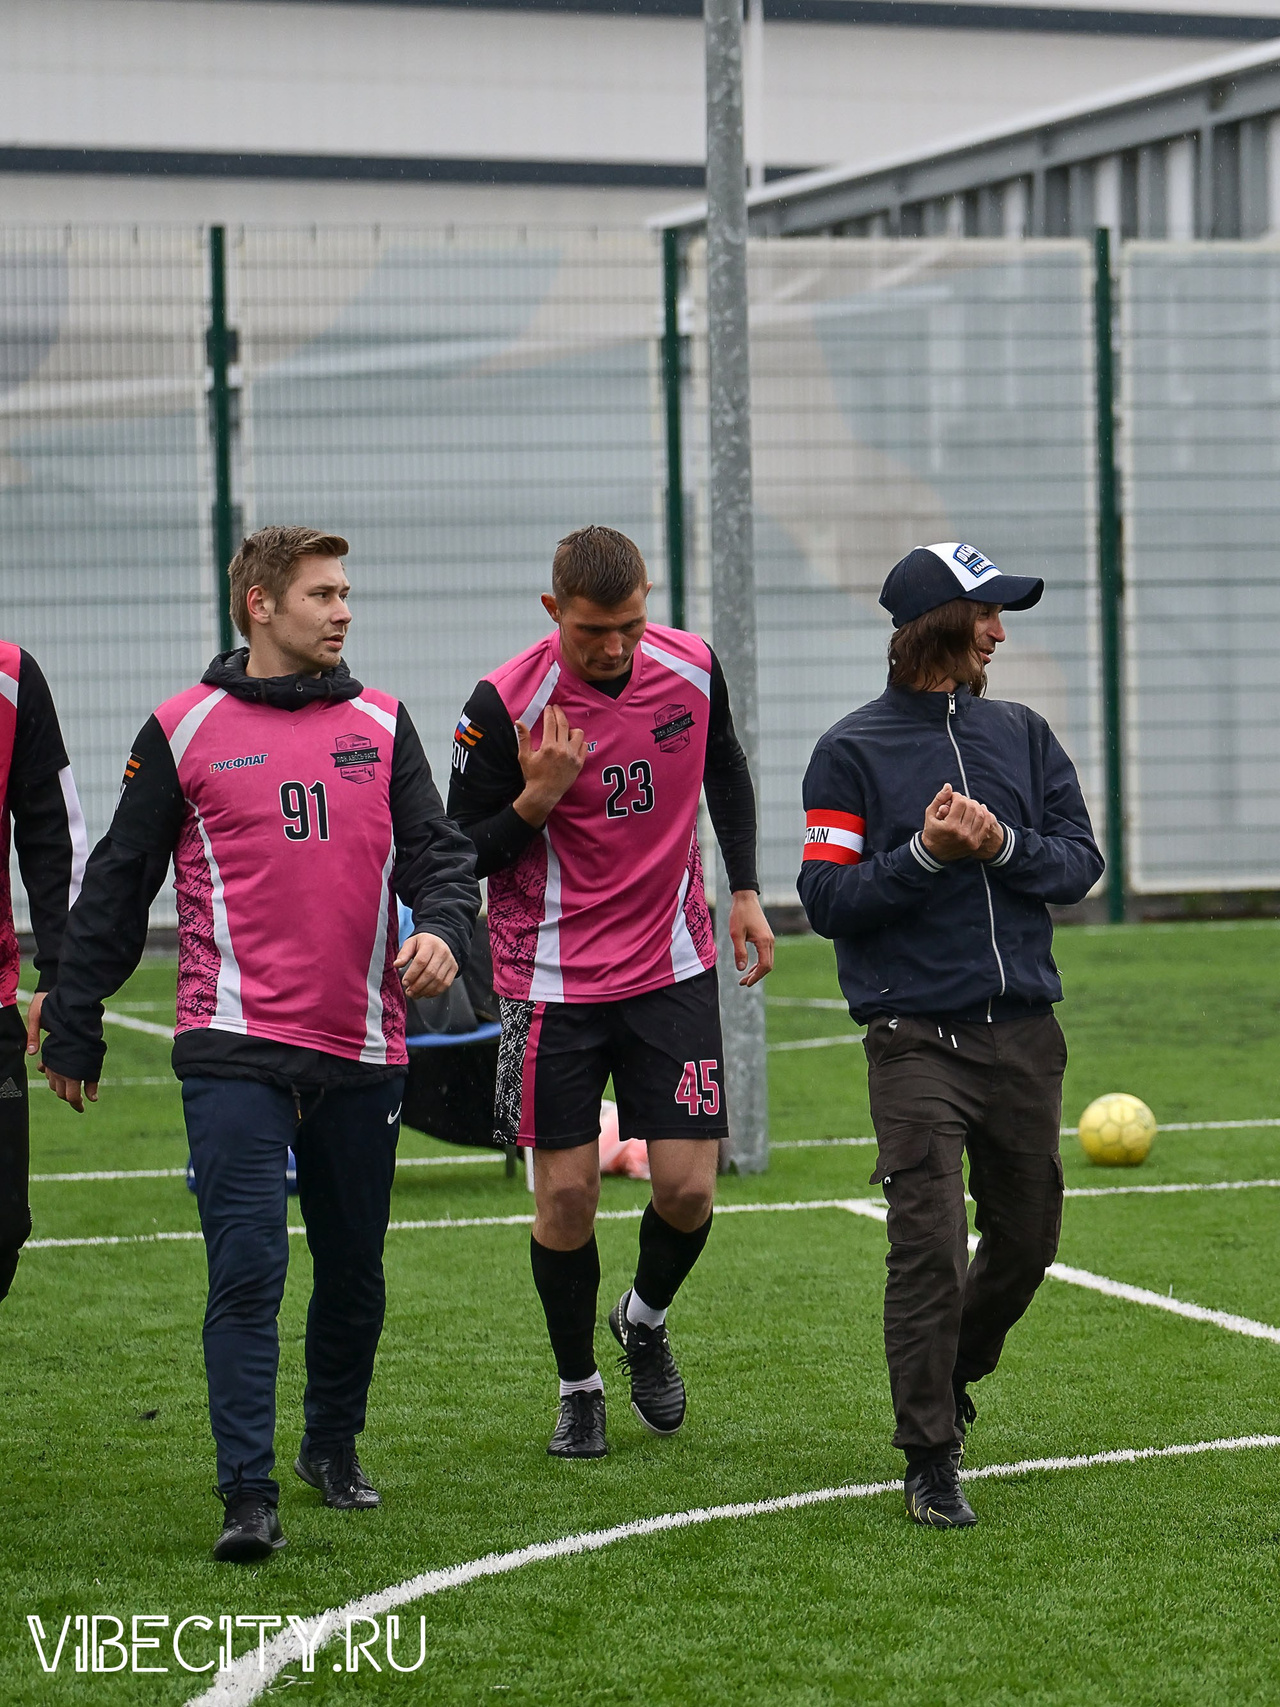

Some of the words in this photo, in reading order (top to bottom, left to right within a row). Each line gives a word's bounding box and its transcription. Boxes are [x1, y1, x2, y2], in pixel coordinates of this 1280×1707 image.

[209, 753, 268, 774] РУСФЛАГ
[602, 759, 655, 819] 23
[279, 780, 330, 842] 91
[805, 827, 830, 843] TAIN
[674, 1059, 720, 1116] 45
